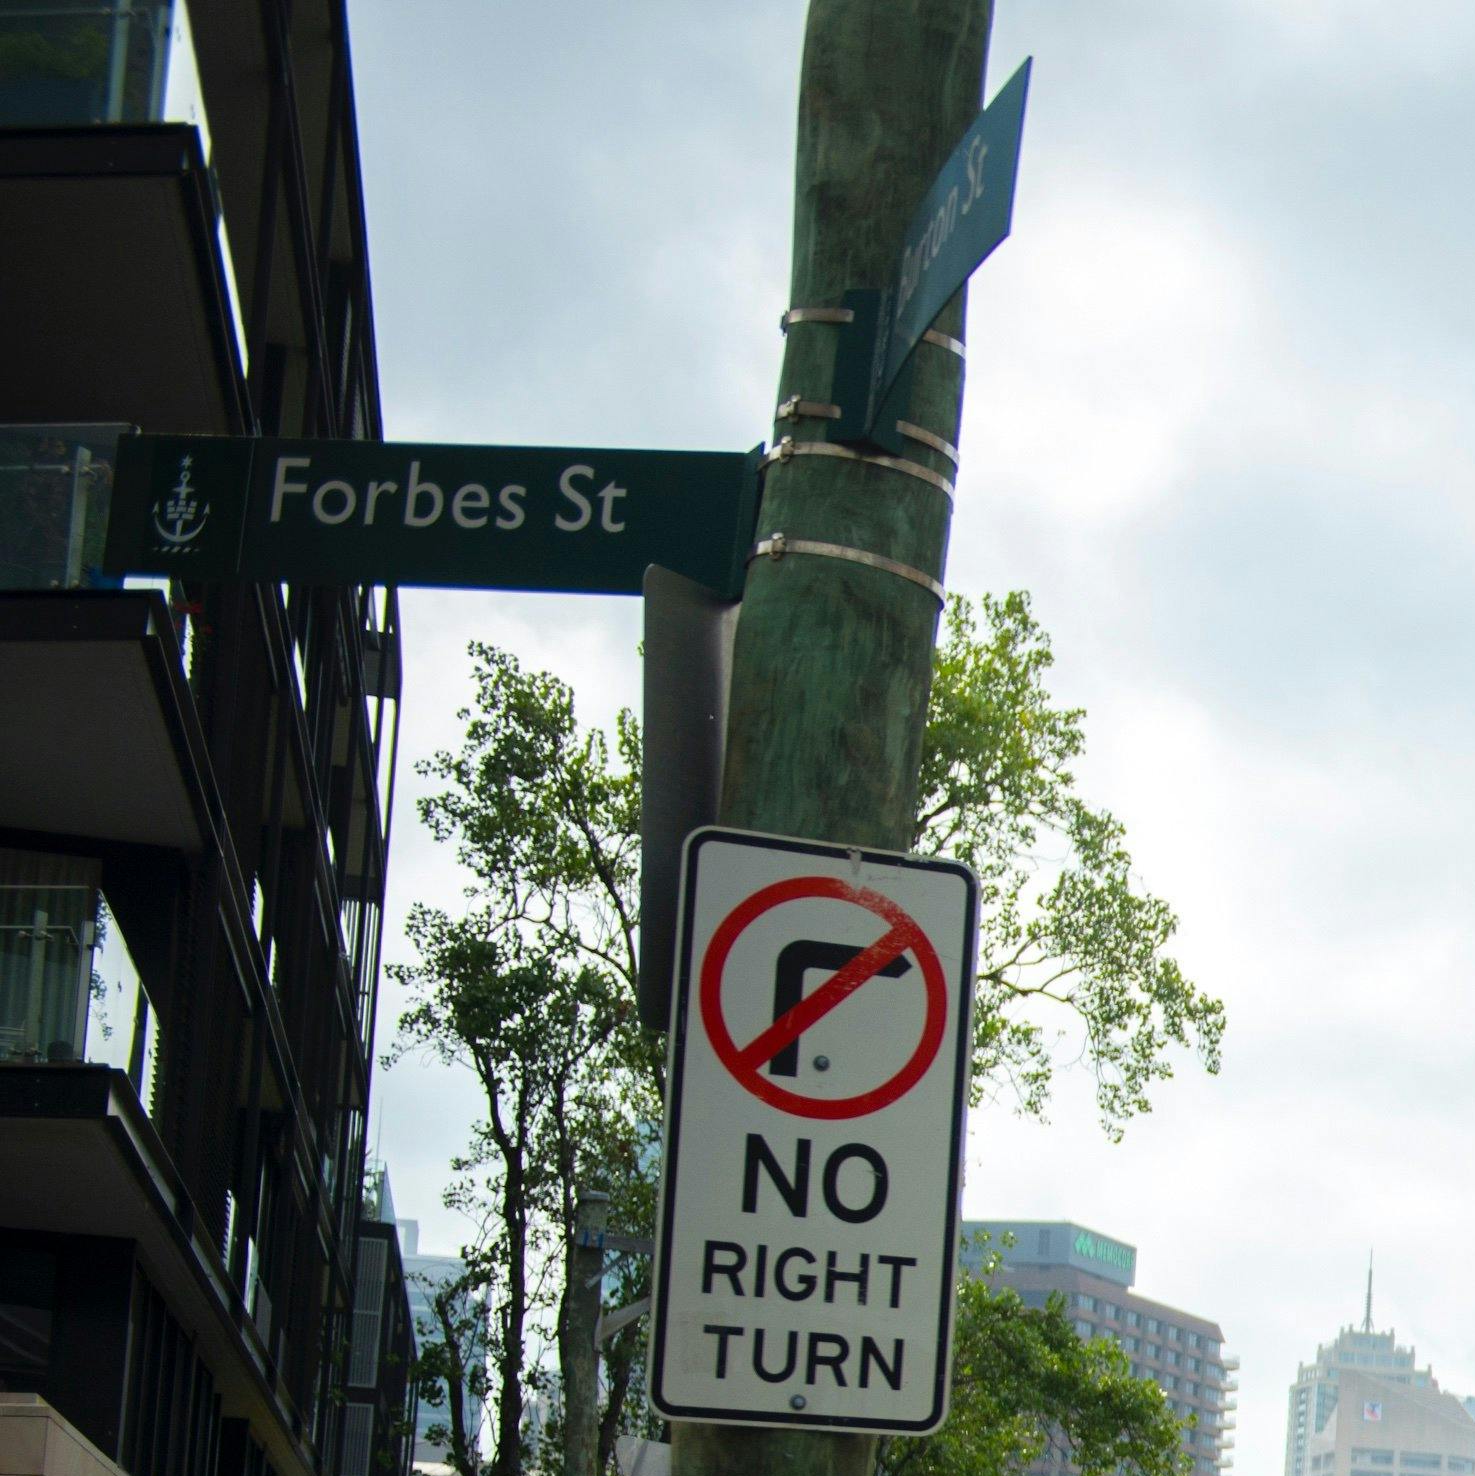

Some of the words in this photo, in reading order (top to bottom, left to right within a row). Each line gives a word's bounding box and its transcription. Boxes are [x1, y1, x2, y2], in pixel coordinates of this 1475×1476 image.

[961, 135, 989, 215] St
[270, 456, 526, 531] Forbes
[554, 464, 627, 533] St
[741, 1133, 888, 1224] NO
[701, 1240, 917, 1308] RIGHT
[703, 1324, 904, 1391] TURN
